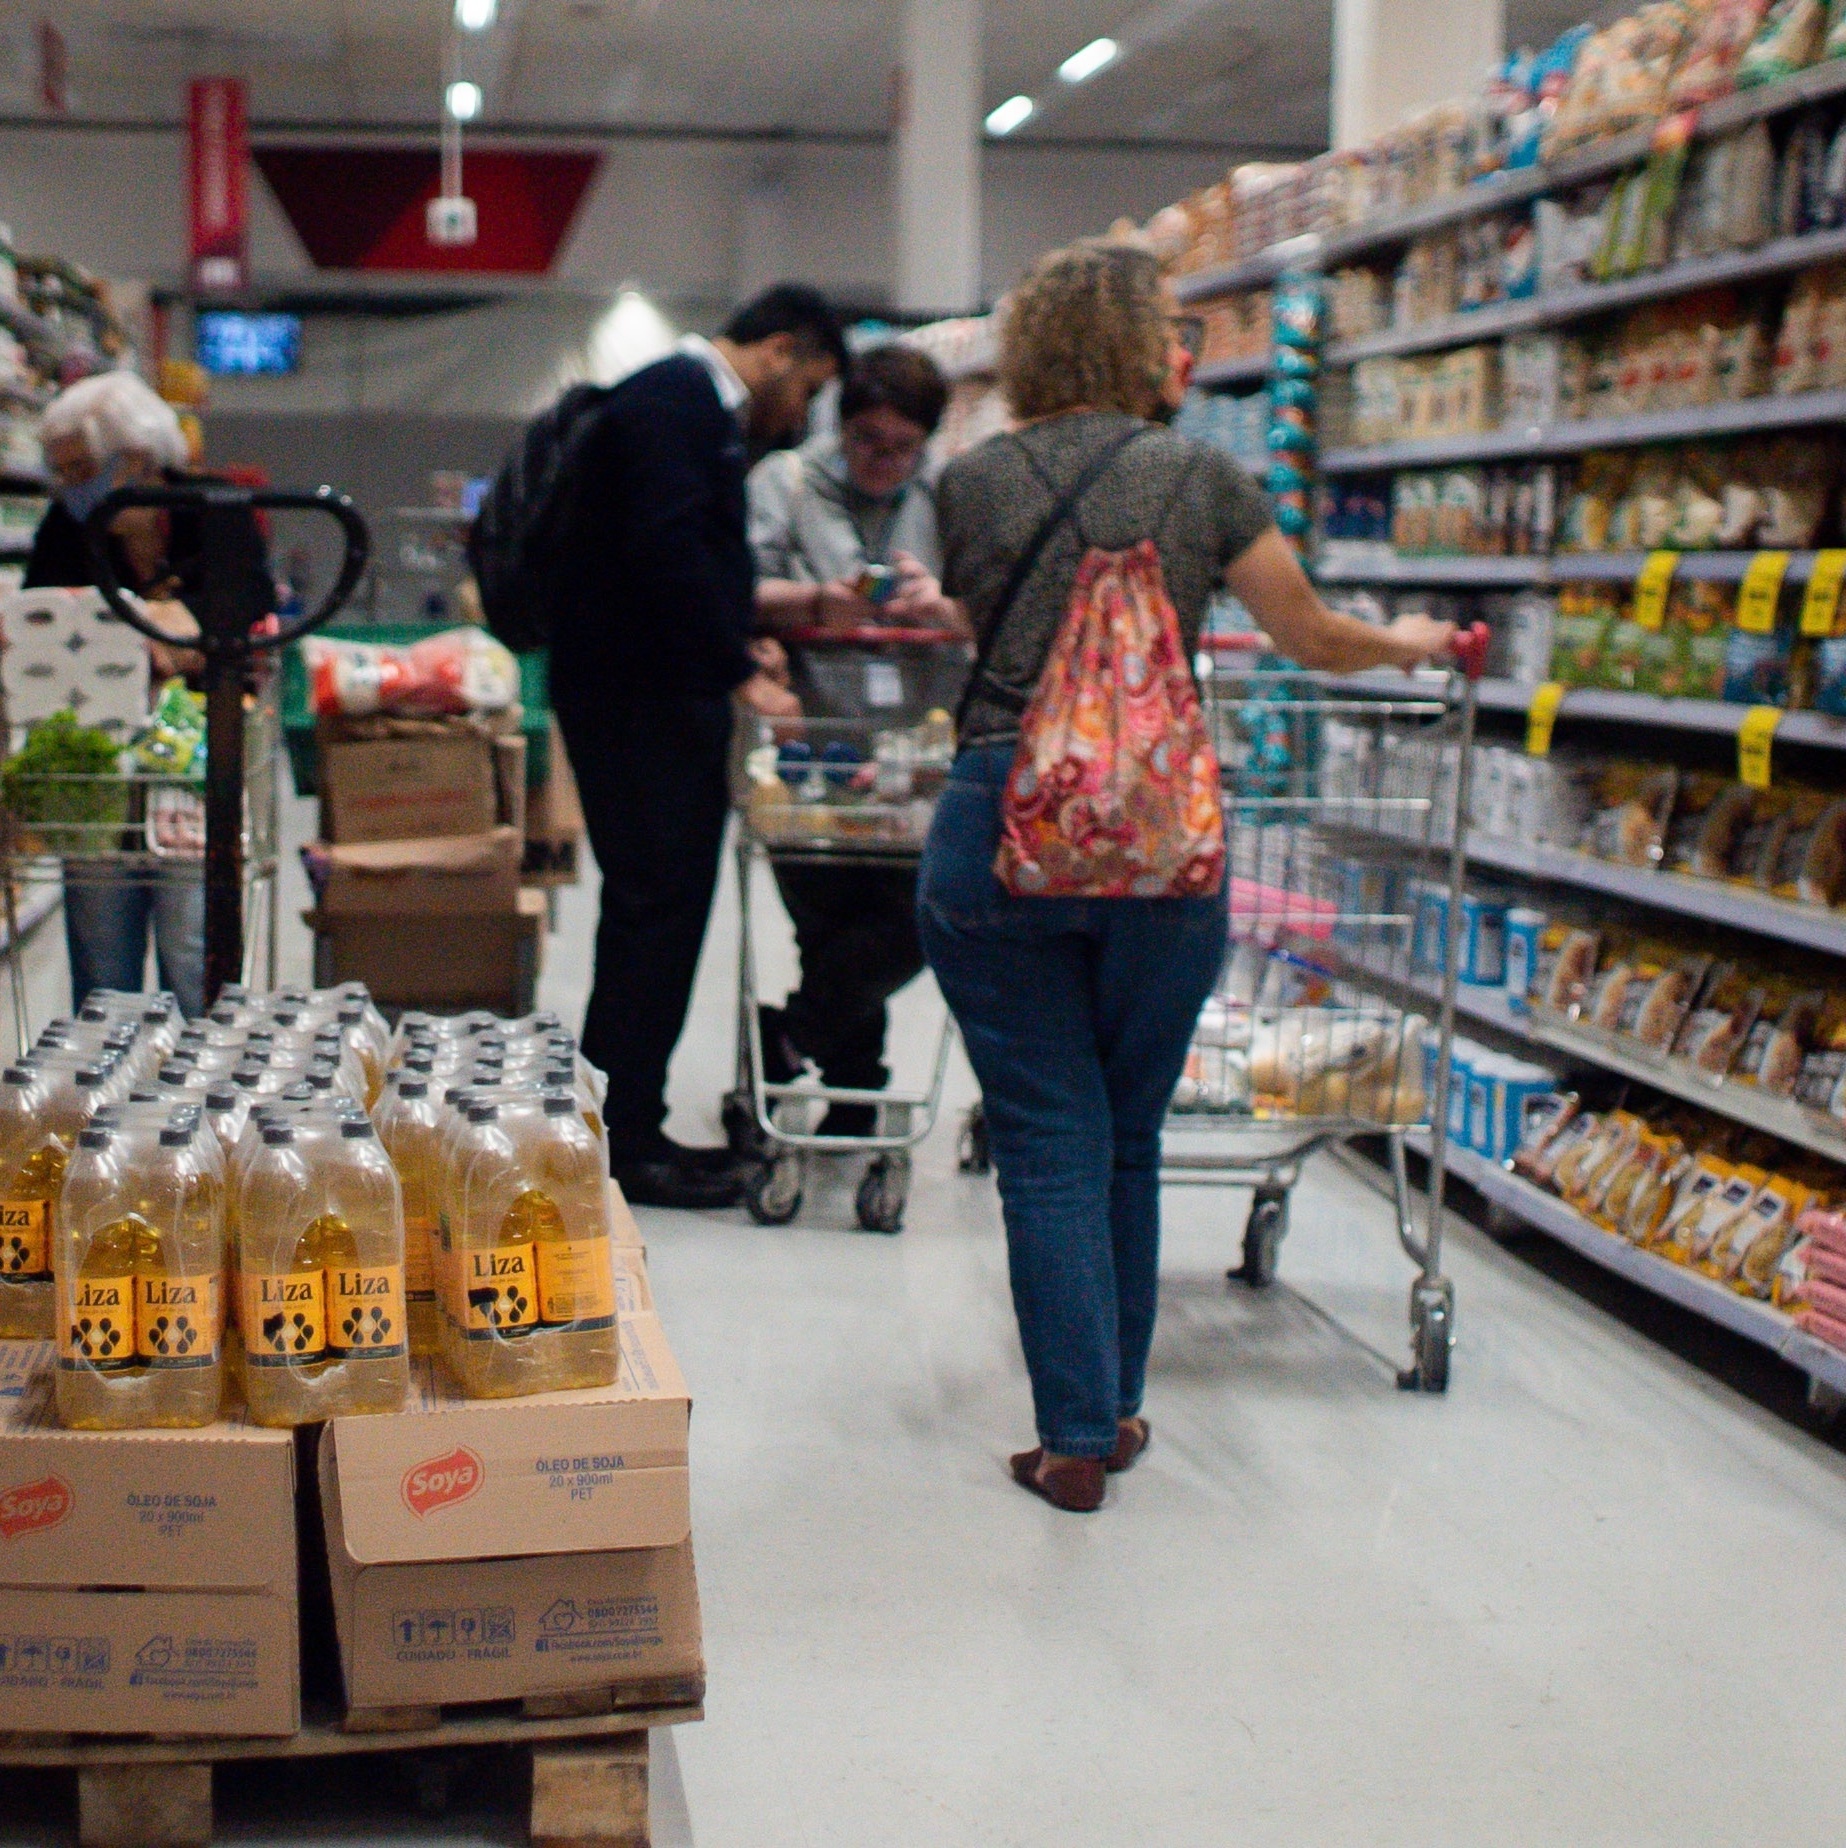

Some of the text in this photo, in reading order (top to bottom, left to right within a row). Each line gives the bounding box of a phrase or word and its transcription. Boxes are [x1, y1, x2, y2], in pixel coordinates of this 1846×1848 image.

[0, 1205, 30, 1226] iza
[472, 1253, 525, 1277] Liza
[145, 1281, 198, 1305] Liza
[261, 1279, 314, 1302] Liza
[338, 1273, 390, 1296] Liza
[535, 1455, 625, 1472] ÓLEO DE SOJA
[411, 1465, 474, 1496] Soya
[549, 1474, 565, 1488] 20
[576, 1472, 614, 1487] 900ml
[570, 1486, 595, 1500] PET
[0, 1494, 63, 1521] Soya
